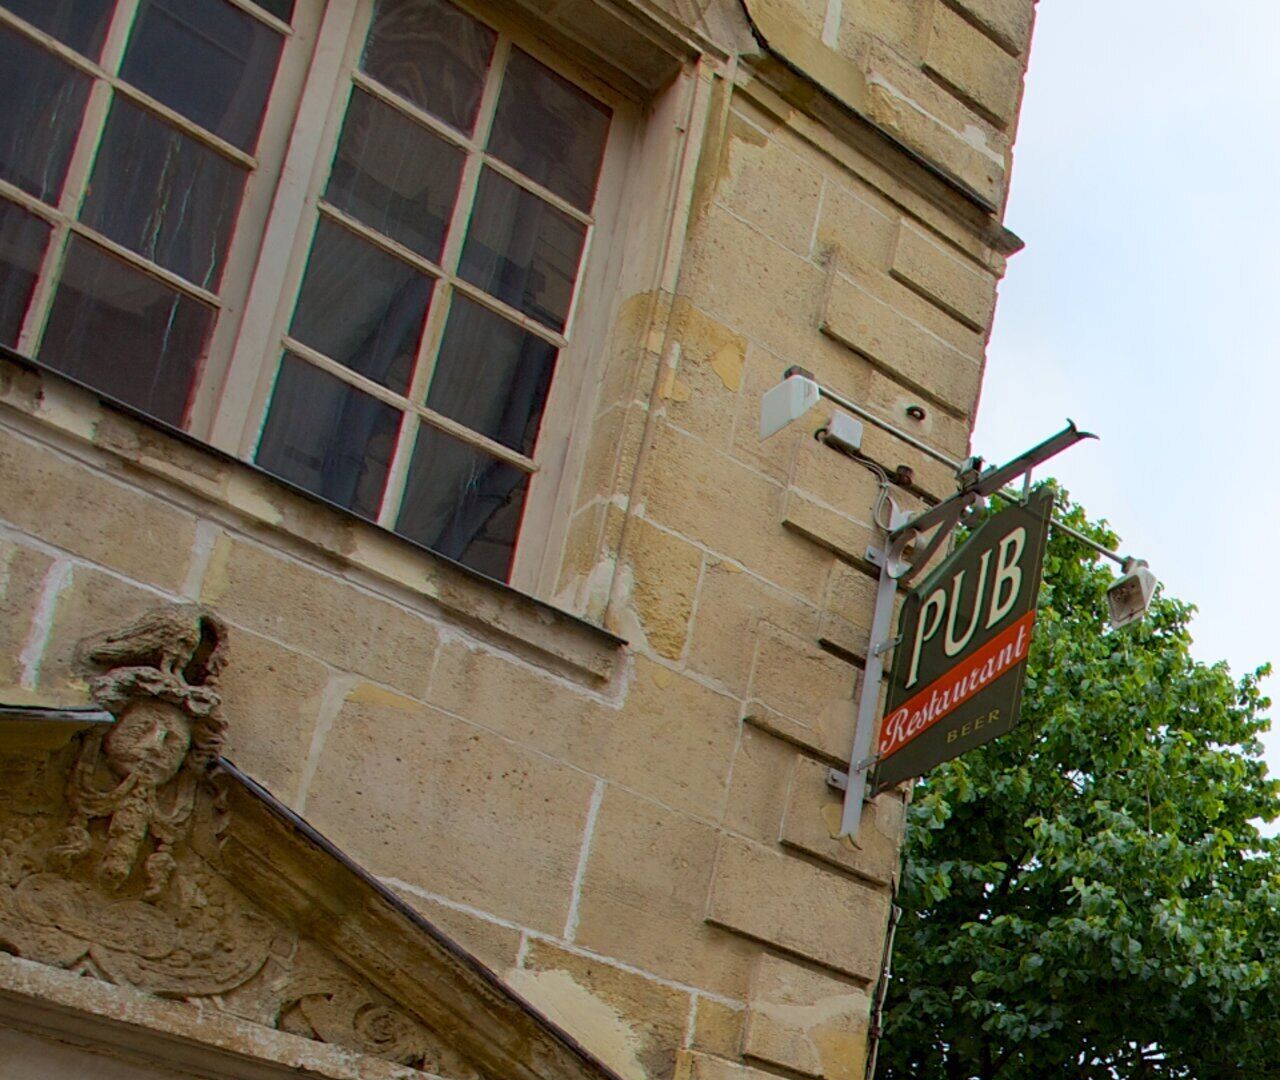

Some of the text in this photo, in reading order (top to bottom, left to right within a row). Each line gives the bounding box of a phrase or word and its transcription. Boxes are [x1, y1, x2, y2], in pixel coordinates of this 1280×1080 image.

[904, 526, 1027, 689] PUB
[880, 625, 1028, 752] Restaurant
[946, 709, 1001, 743] BEER
